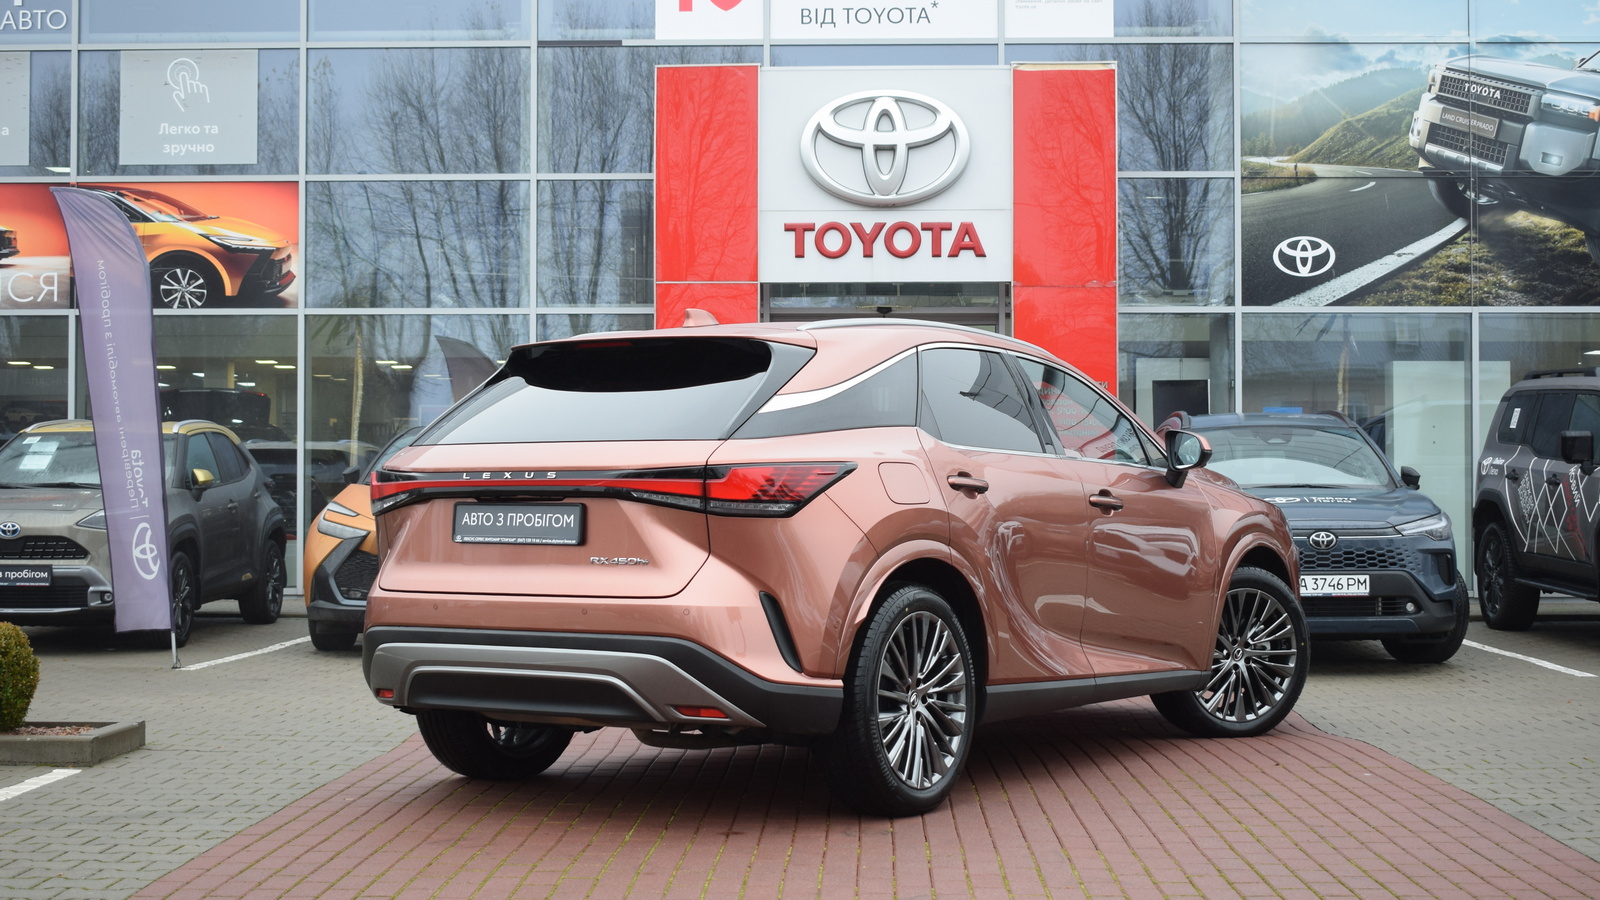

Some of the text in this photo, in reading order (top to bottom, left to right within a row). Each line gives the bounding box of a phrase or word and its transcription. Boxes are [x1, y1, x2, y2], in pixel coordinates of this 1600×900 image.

[0, 9, 68, 30] АВТО
[800, 8, 836, 28] ВІД
[1464, 83, 1501, 99] TOYOTA
[159, 123, 219, 136] Легко та
[1441, 112, 1456, 121] LAND
[1476, 121, 1495, 132] PRADO
[163, 143, 215, 156] зручно
[784, 221, 987, 260] TOYOTA
[1, 272, 58, 302] СЯ
[463, 471, 557, 480] LEXUS
[461, 512, 574, 528] АВТО З ПРОБІГОМ
[5, 569, 48, 580] пробігом
[1311, 577, 1344, 591] 3746
[1346, 577, 1367, 591] PM
